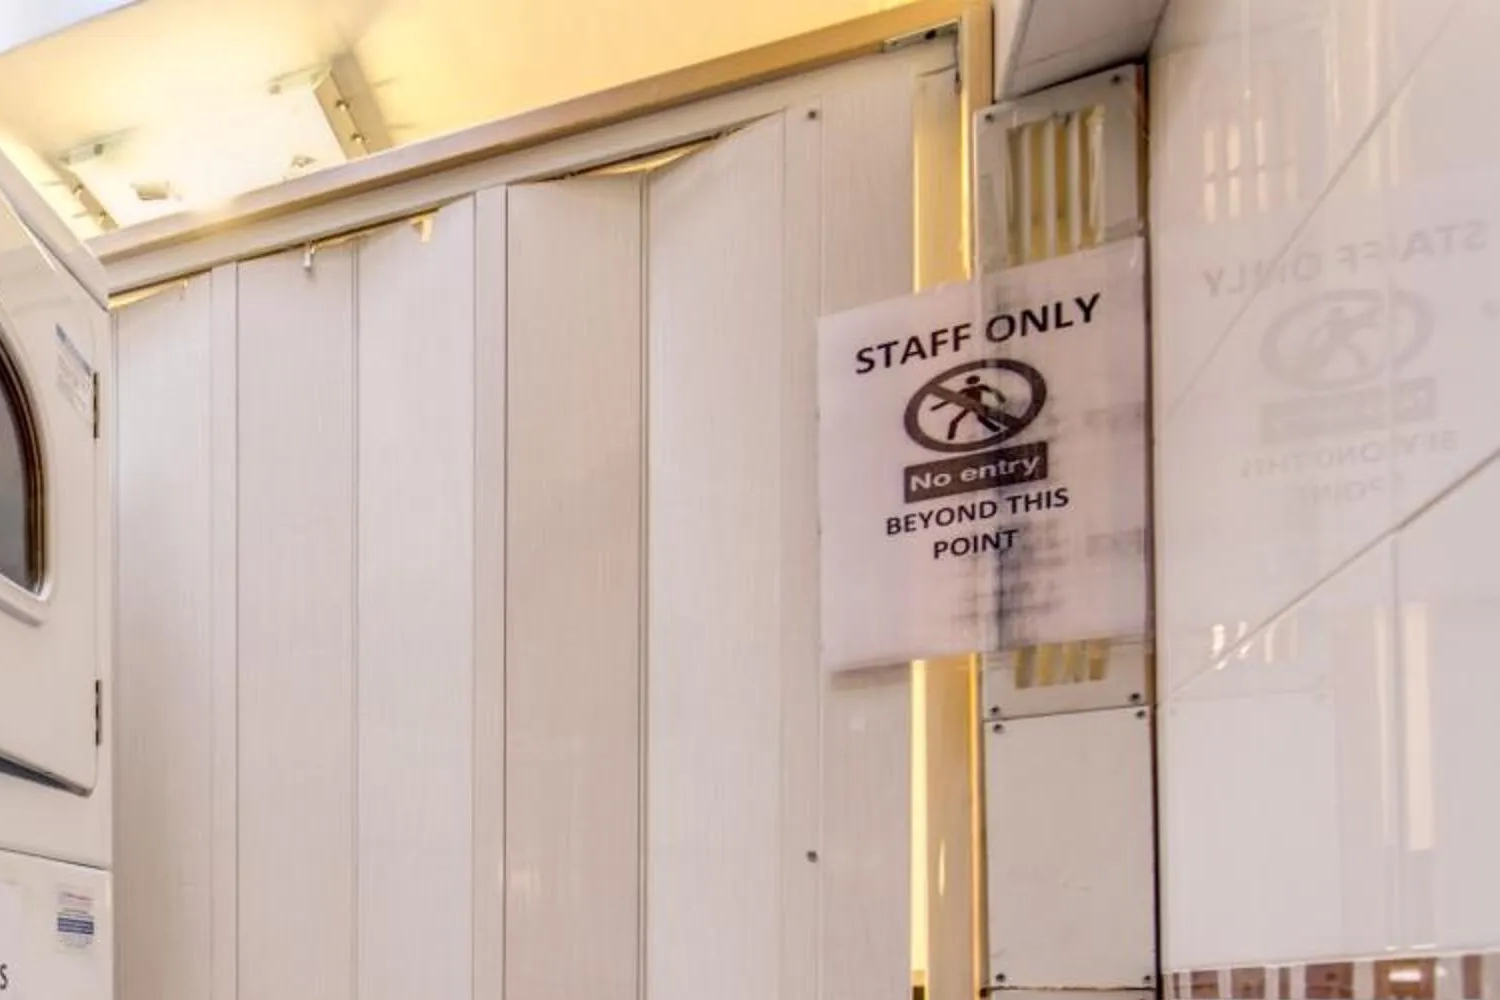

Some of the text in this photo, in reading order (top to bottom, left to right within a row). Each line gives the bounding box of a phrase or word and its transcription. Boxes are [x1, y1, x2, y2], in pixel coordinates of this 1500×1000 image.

[855, 292, 1101, 375] STAFF ONLY
[910, 455, 1041, 493] No entry
[886, 487, 1070, 536] BEYOND THIS
[933, 529, 1019, 560] POINT
